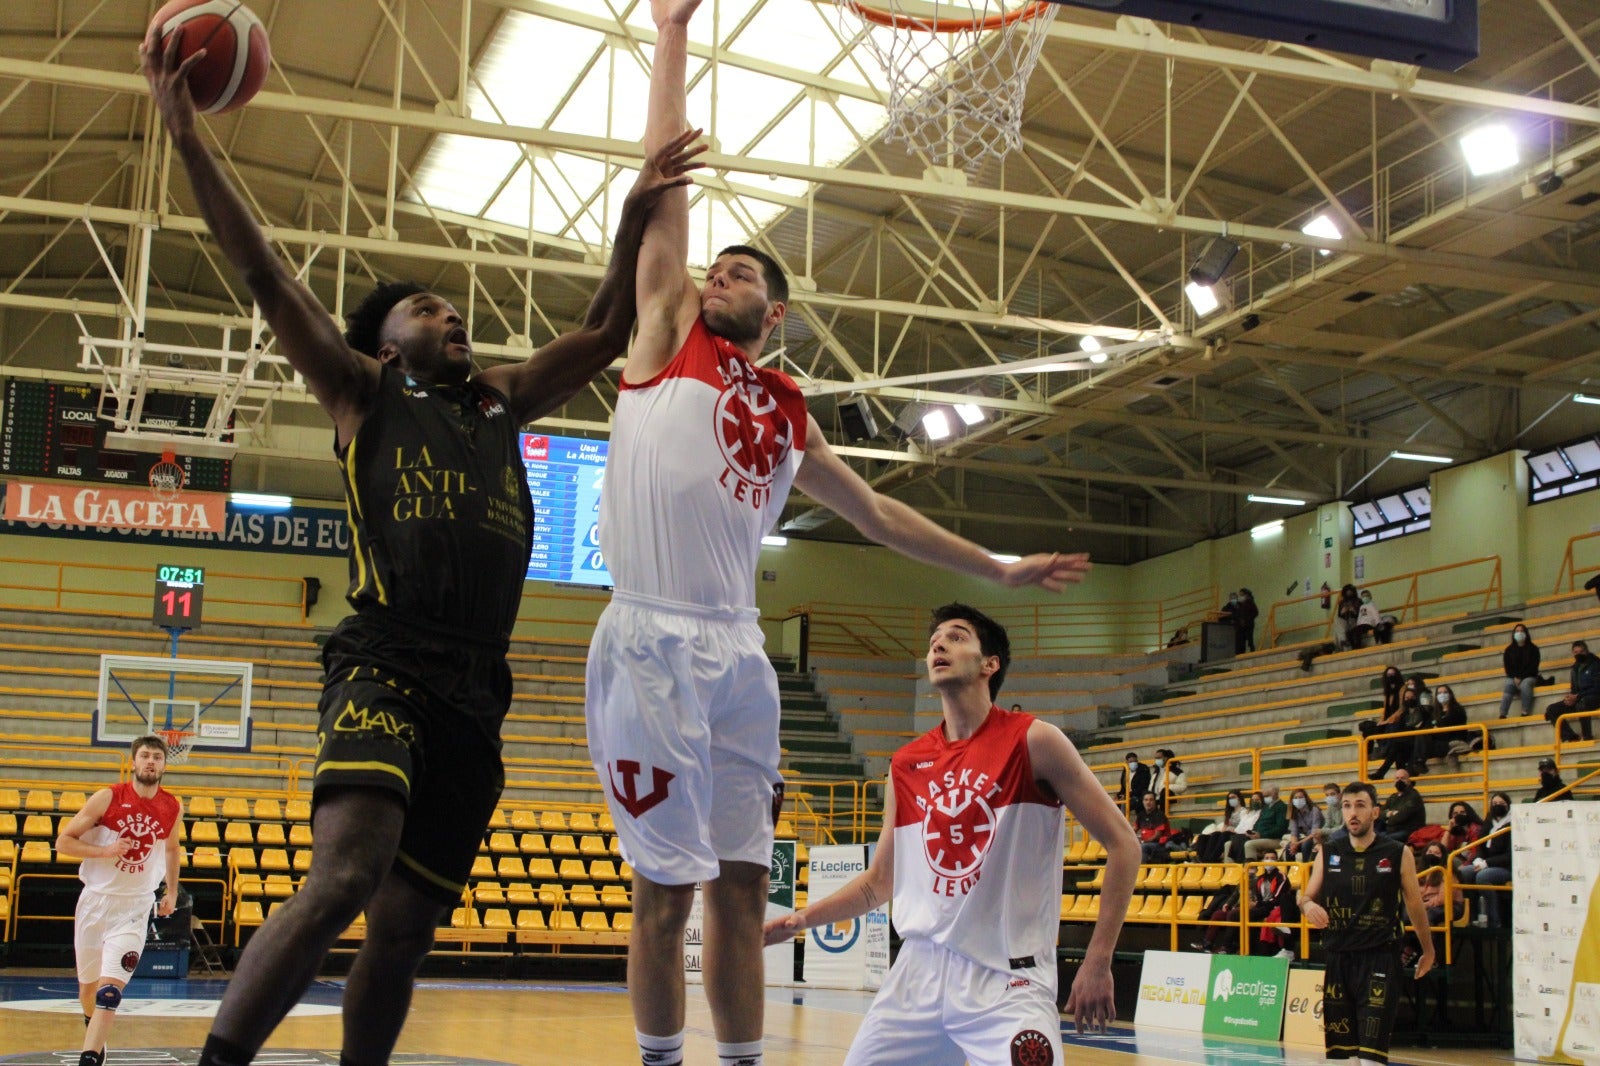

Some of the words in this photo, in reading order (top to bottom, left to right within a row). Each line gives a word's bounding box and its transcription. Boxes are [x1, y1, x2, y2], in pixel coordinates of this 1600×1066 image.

[62, 411, 96, 421] LOCAL
[146, 418, 178, 426] VISITANTE
[752, 421, 764, 444] 7
[394, 445, 433, 469] LA
[566, 452, 577, 460] La
[579, 444, 599, 453] Usal
[57, 466, 81, 476] FALTAS
[104, 470, 128, 479] JUGADOR
[394, 470, 478, 496] ANTI-
[18, 484, 67, 521] LA
[73, 489, 211, 529] GACETA
[393, 496, 456, 522] GUA
[272, 516, 309, 547] DE
[160, 566, 202, 583] 07:51
[162, 590, 192, 617] 11
[915, 768, 1003, 811] BASKET
[117, 813, 164, 836] BASKET
[950, 824, 964, 845] 5
[114, 860, 144, 873] LEON
[932, 870, 981, 897] LEON
[1289, 997, 1309, 1013] El
[1014, 1033, 1049, 1047] BASKET
